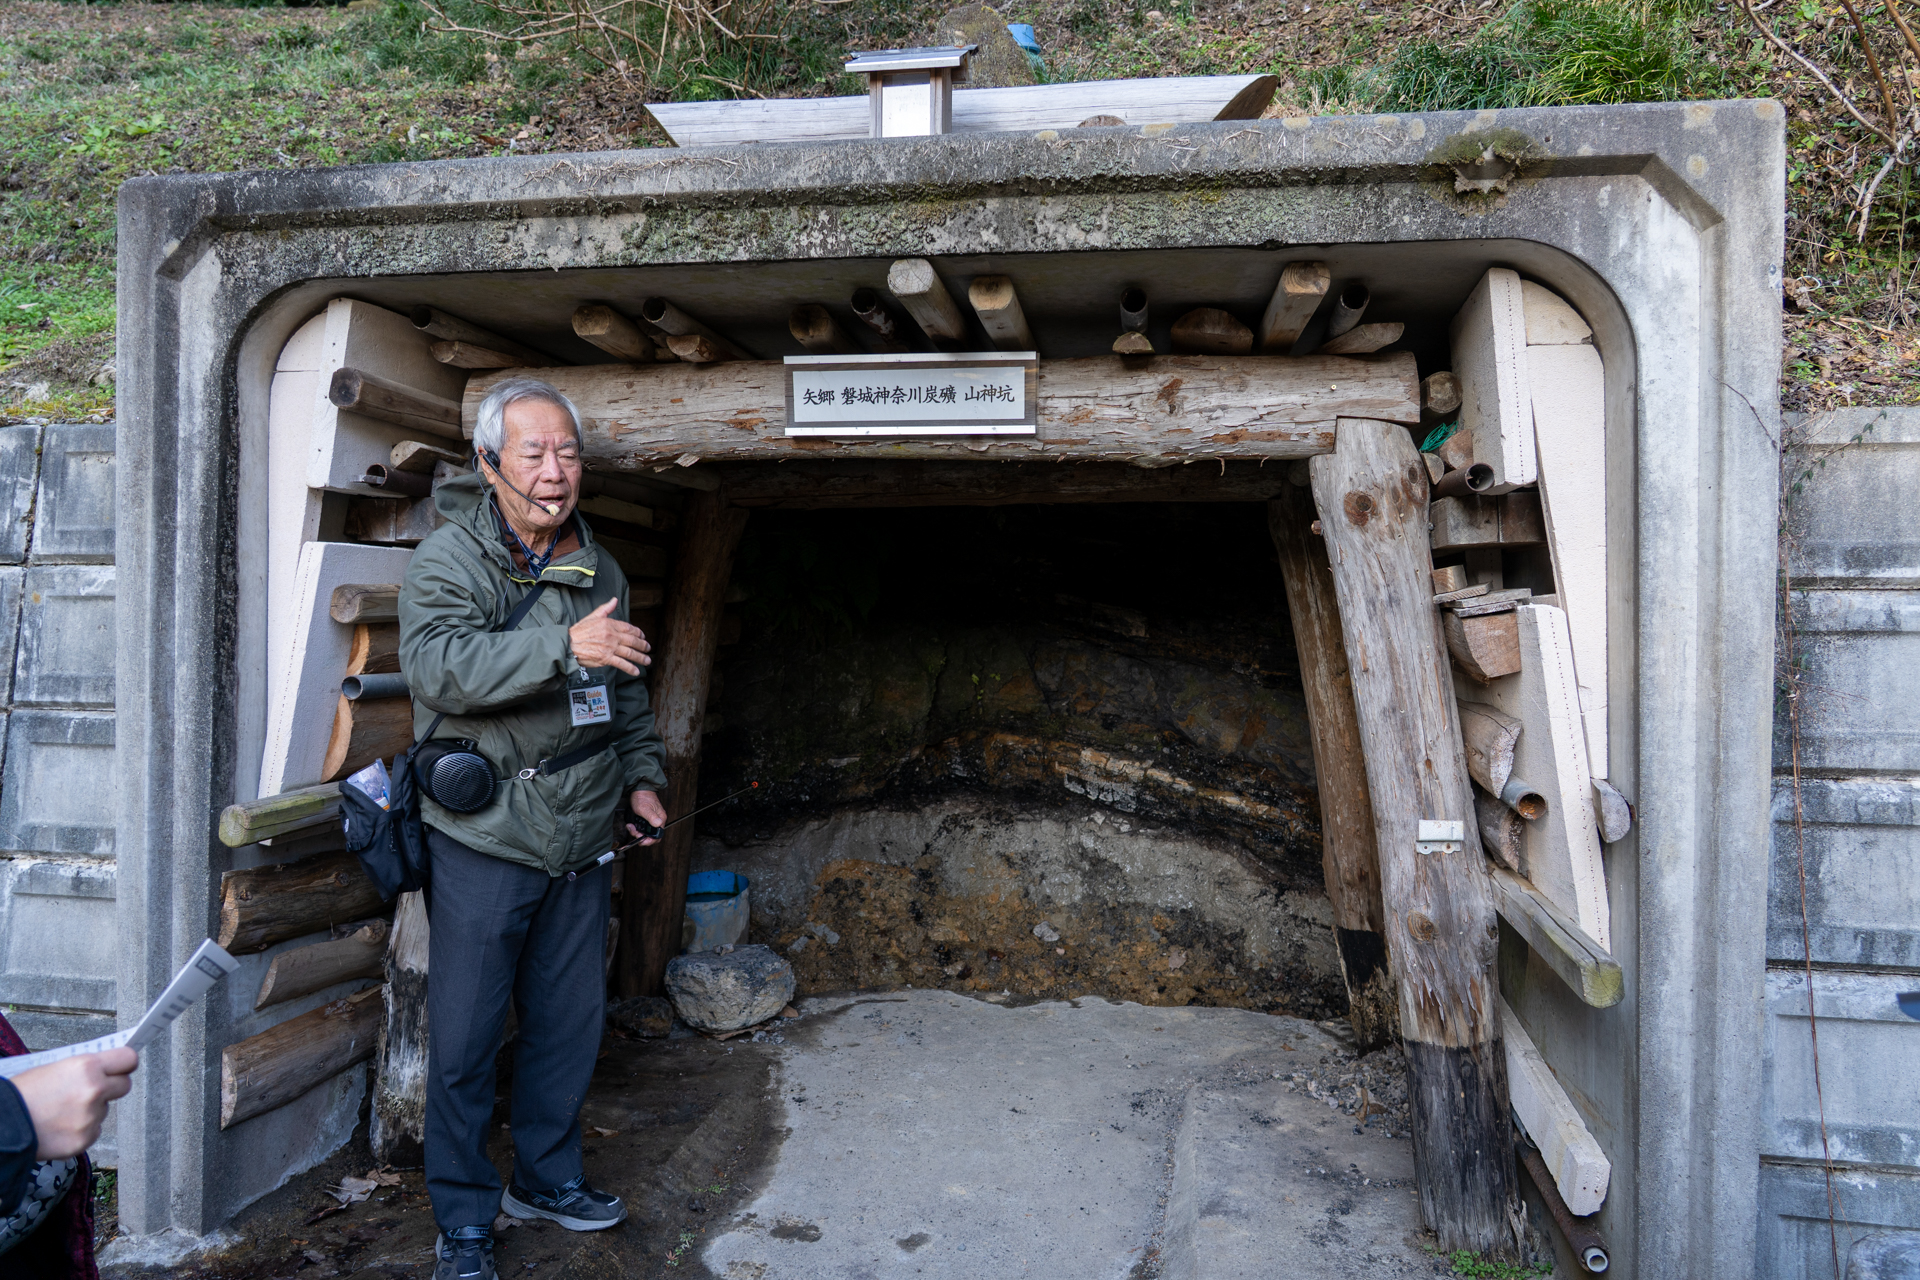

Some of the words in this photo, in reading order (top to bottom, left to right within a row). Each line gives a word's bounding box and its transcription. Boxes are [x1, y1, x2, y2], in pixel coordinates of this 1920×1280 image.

[803, 388, 835, 406] 矢郷
[964, 384, 1015, 403] 山神坑
